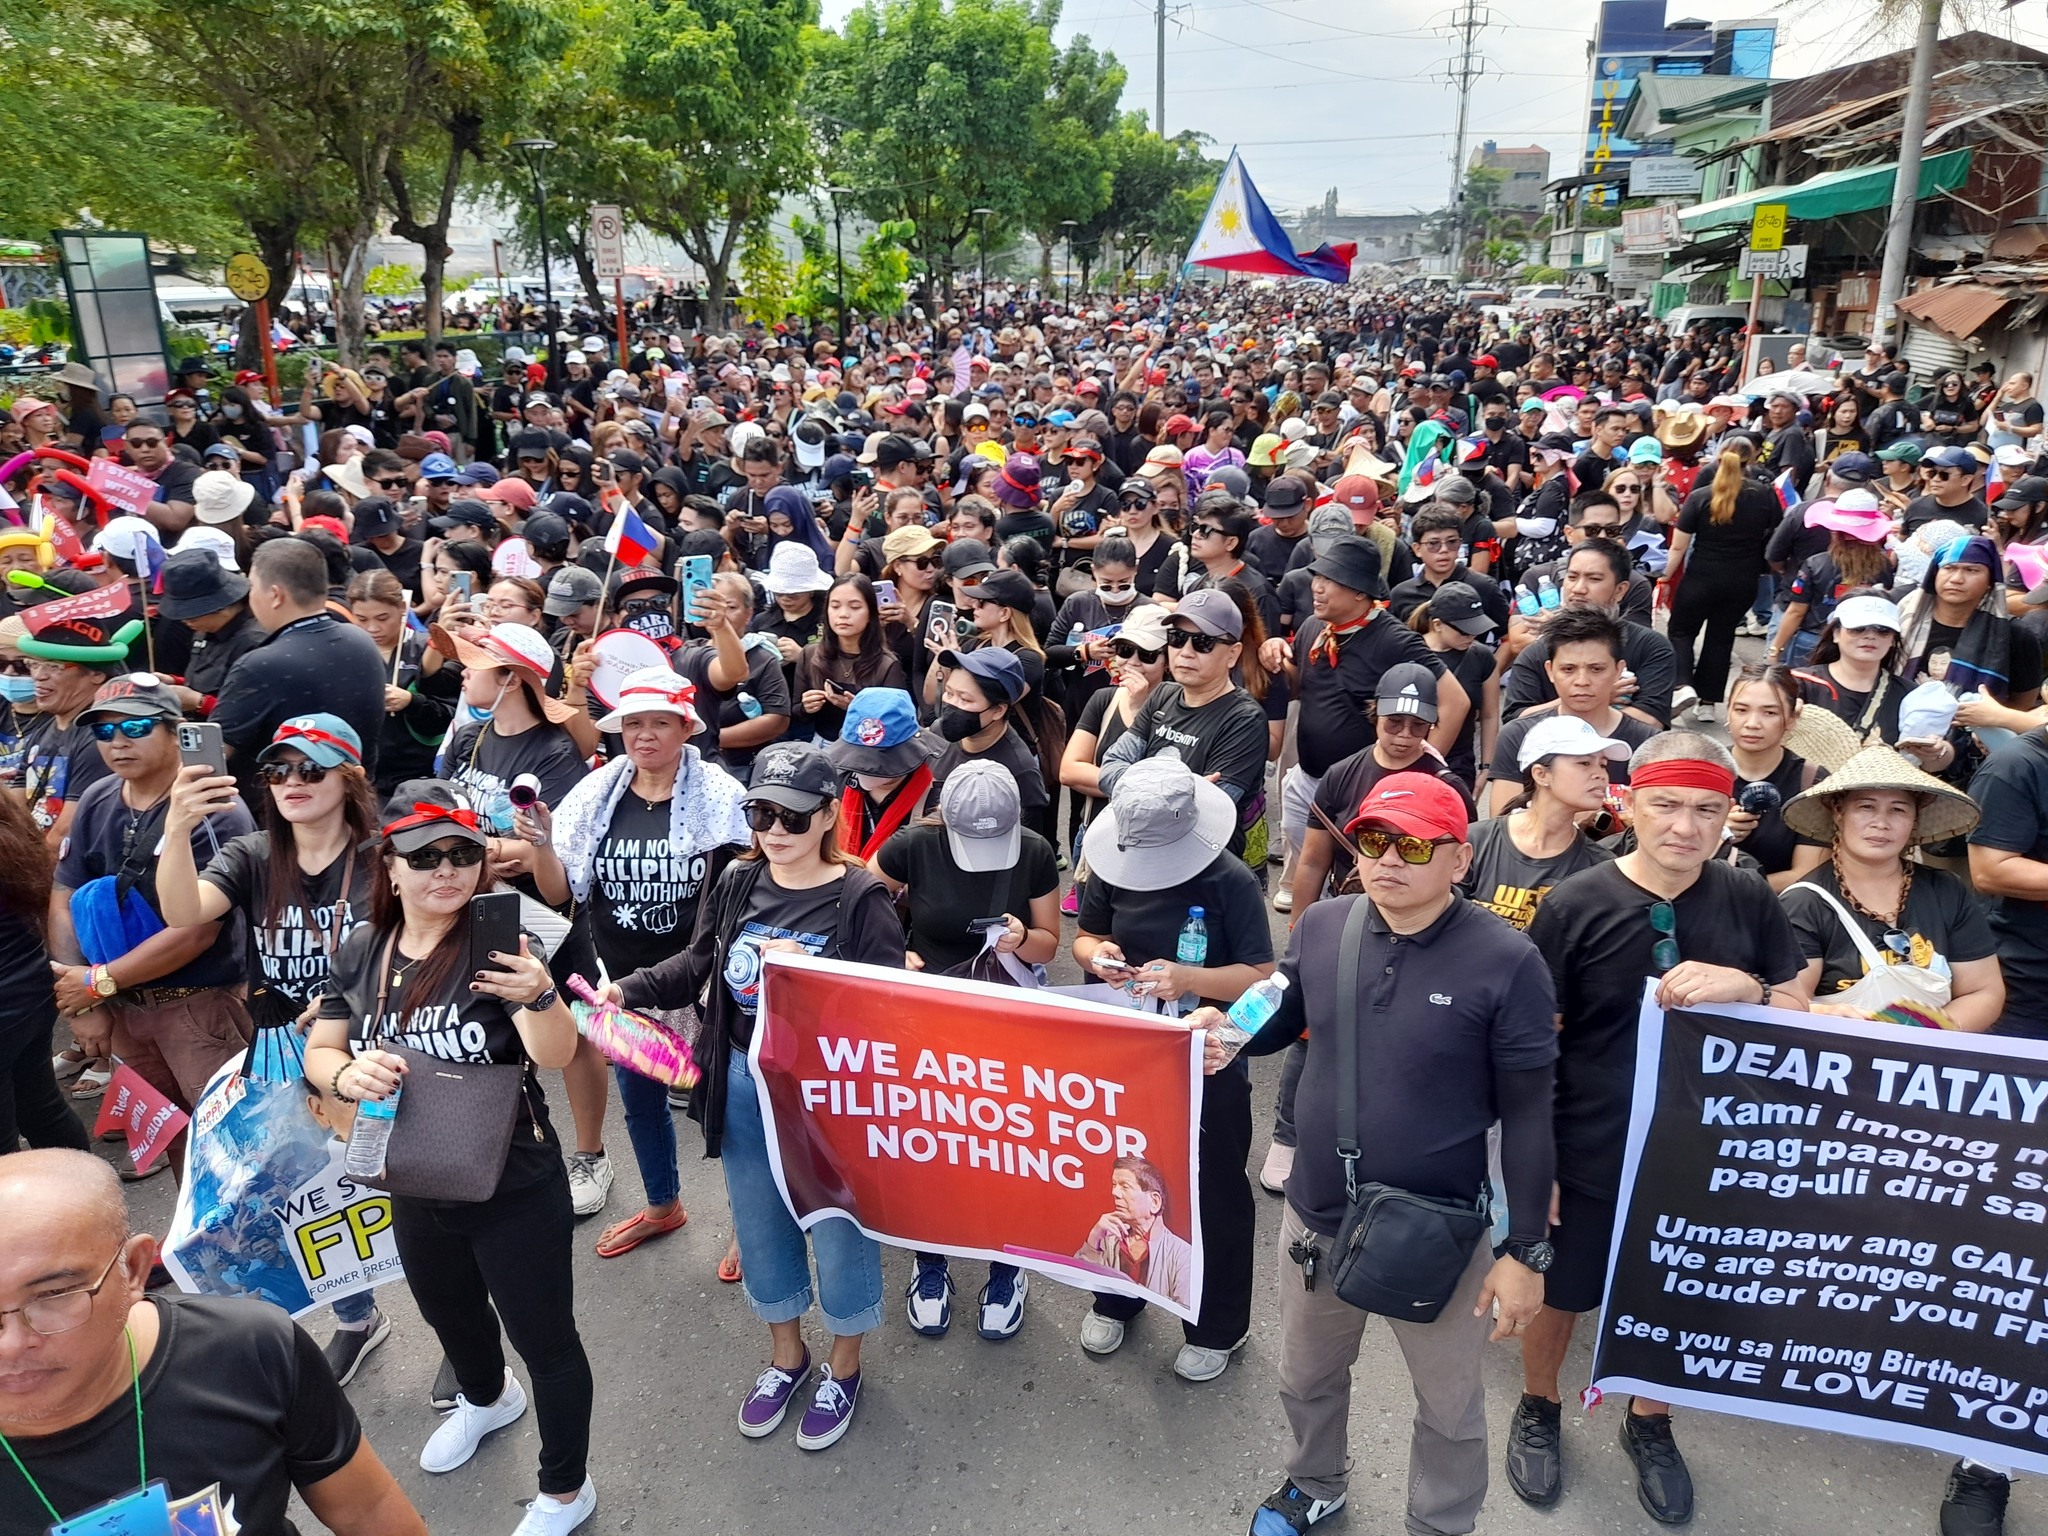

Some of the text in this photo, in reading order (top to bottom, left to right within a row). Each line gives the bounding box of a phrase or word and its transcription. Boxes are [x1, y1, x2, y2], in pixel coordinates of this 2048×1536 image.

[105, 479, 140, 498] WITH
[107, 465, 154, 488] STAND
[44, 582, 123, 613] STAND
[595, 857, 706, 882] FILIPINO
[604, 838, 674, 858] I AM NO
[772, 927, 829, 946] VILLAGE
[362, 1014, 372, 1039] I
[406, 1006, 445, 1033] NOT
[446, 1003, 460, 1028] A
[817, 1035, 1125, 1116] WE ARE NOT
[1702, 1034, 2048, 1123] DEAR TATAY
[801, 1079, 1148, 1159] FILIPINOS FOR
[1701, 1096, 1822, 1126] Kami
[1836, 1110, 1999, 1160] imong
[867, 1123, 1084, 1189] NOTHING
[1719, 1136, 1998, 1183] nag-paabot
[273, 1187, 331, 1227] WE
[1709, 1167, 2047, 1224] pag-uli diri sa
[1649, 1241, 1705, 1269] We
[1714, 1253, 1776, 1276] are
[1783, 1256, 1946, 1293] stronger
[1952, 1281, 2033, 1312] and
[1655, 1214, 2048, 1287] Umaapaw ang GAL
[308, 1270, 360, 1297] FORMER
[1663, 1272, 1806, 1306] louder
[1817, 1285, 1881, 1312] for
[1890, 1298, 1978, 1330] you
[1614, 1314, 1669, 1343] See
[1675, 1330, 1730, 1353] you
[1738, 1338, 1773, 1358] sa
[1782, 1338, 1873, 1374] imong
[1880, 1348, 2020, 1402] Birthday
[1682, 1354, 1766, 1384] WE
[1781, 1369, 1929, 1410] LOVE
